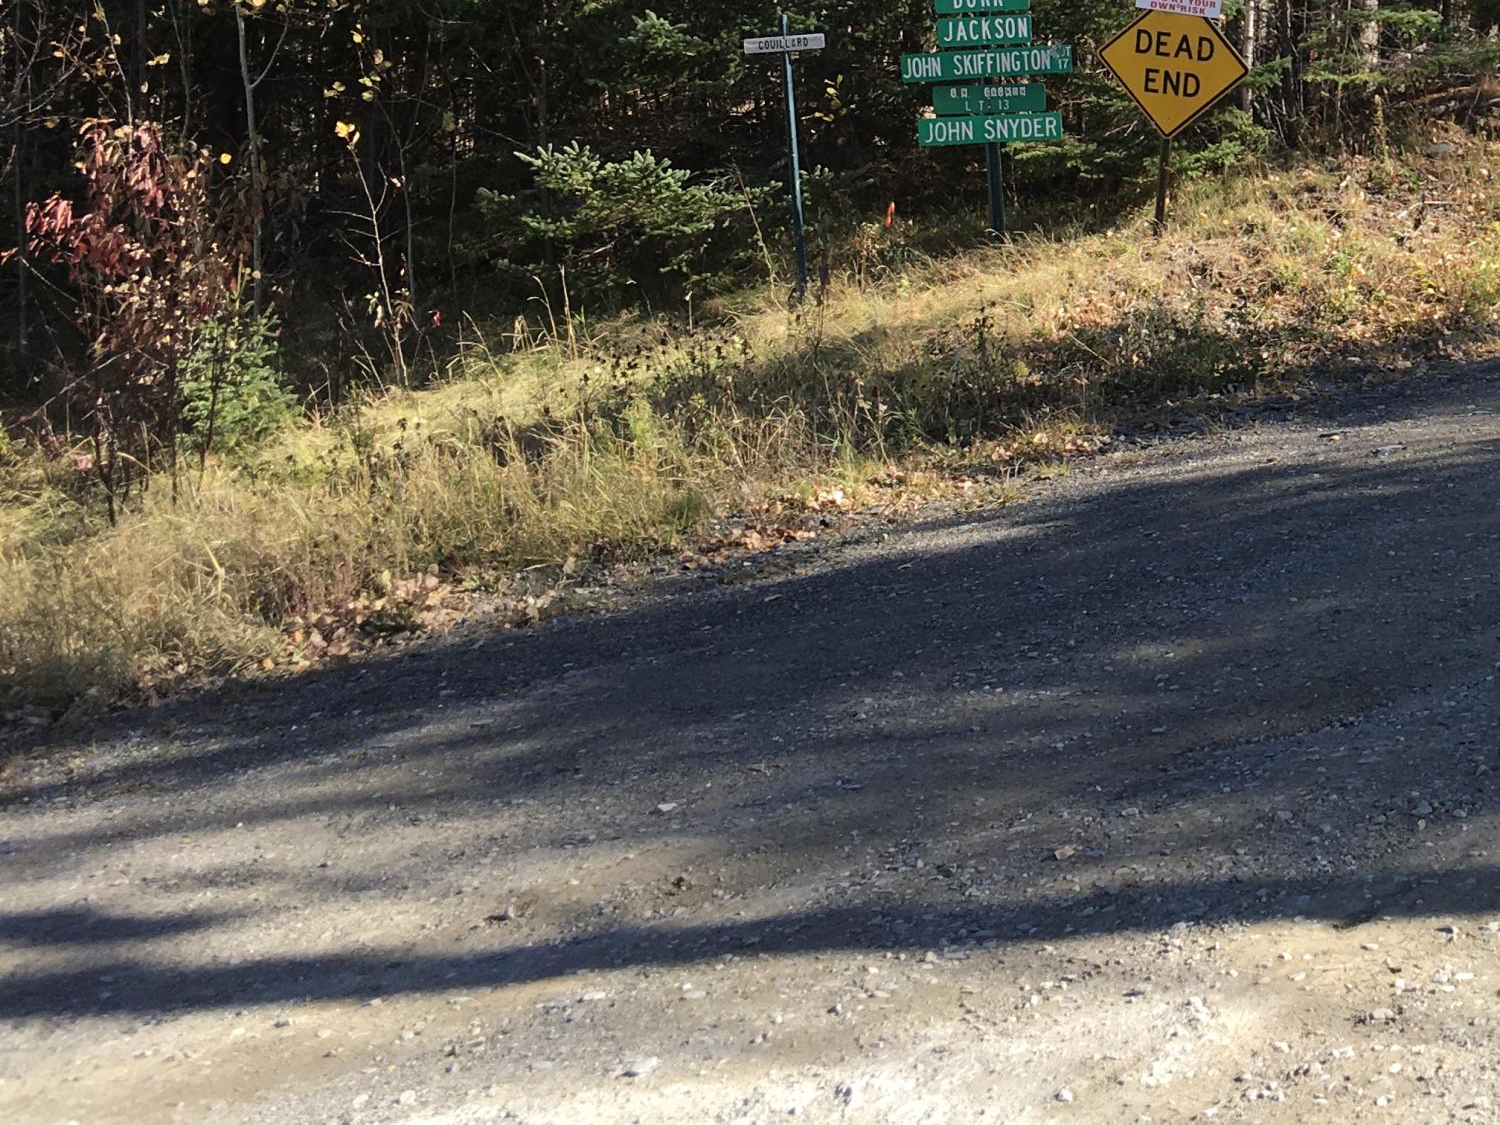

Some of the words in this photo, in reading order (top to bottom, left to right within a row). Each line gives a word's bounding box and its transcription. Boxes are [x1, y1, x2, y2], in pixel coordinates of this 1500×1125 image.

[1150, 1, 1176, 11] OWN
[1180, 5, 1206, 15] RISK
[943, 17, 1029, 42] JACKSON
[758, 37, 809, 50] COUILLARD
[1135, 28, 1215, 62] DEAD
[902, 56, 942, 79] JOHN
[953, 49, 1051, 75] SKIFFINGTON
[1143, 67, 1201, 98] END
[925, 120, 974, 143] JOHN
[984, 117, 1058, 140] SNYDER
